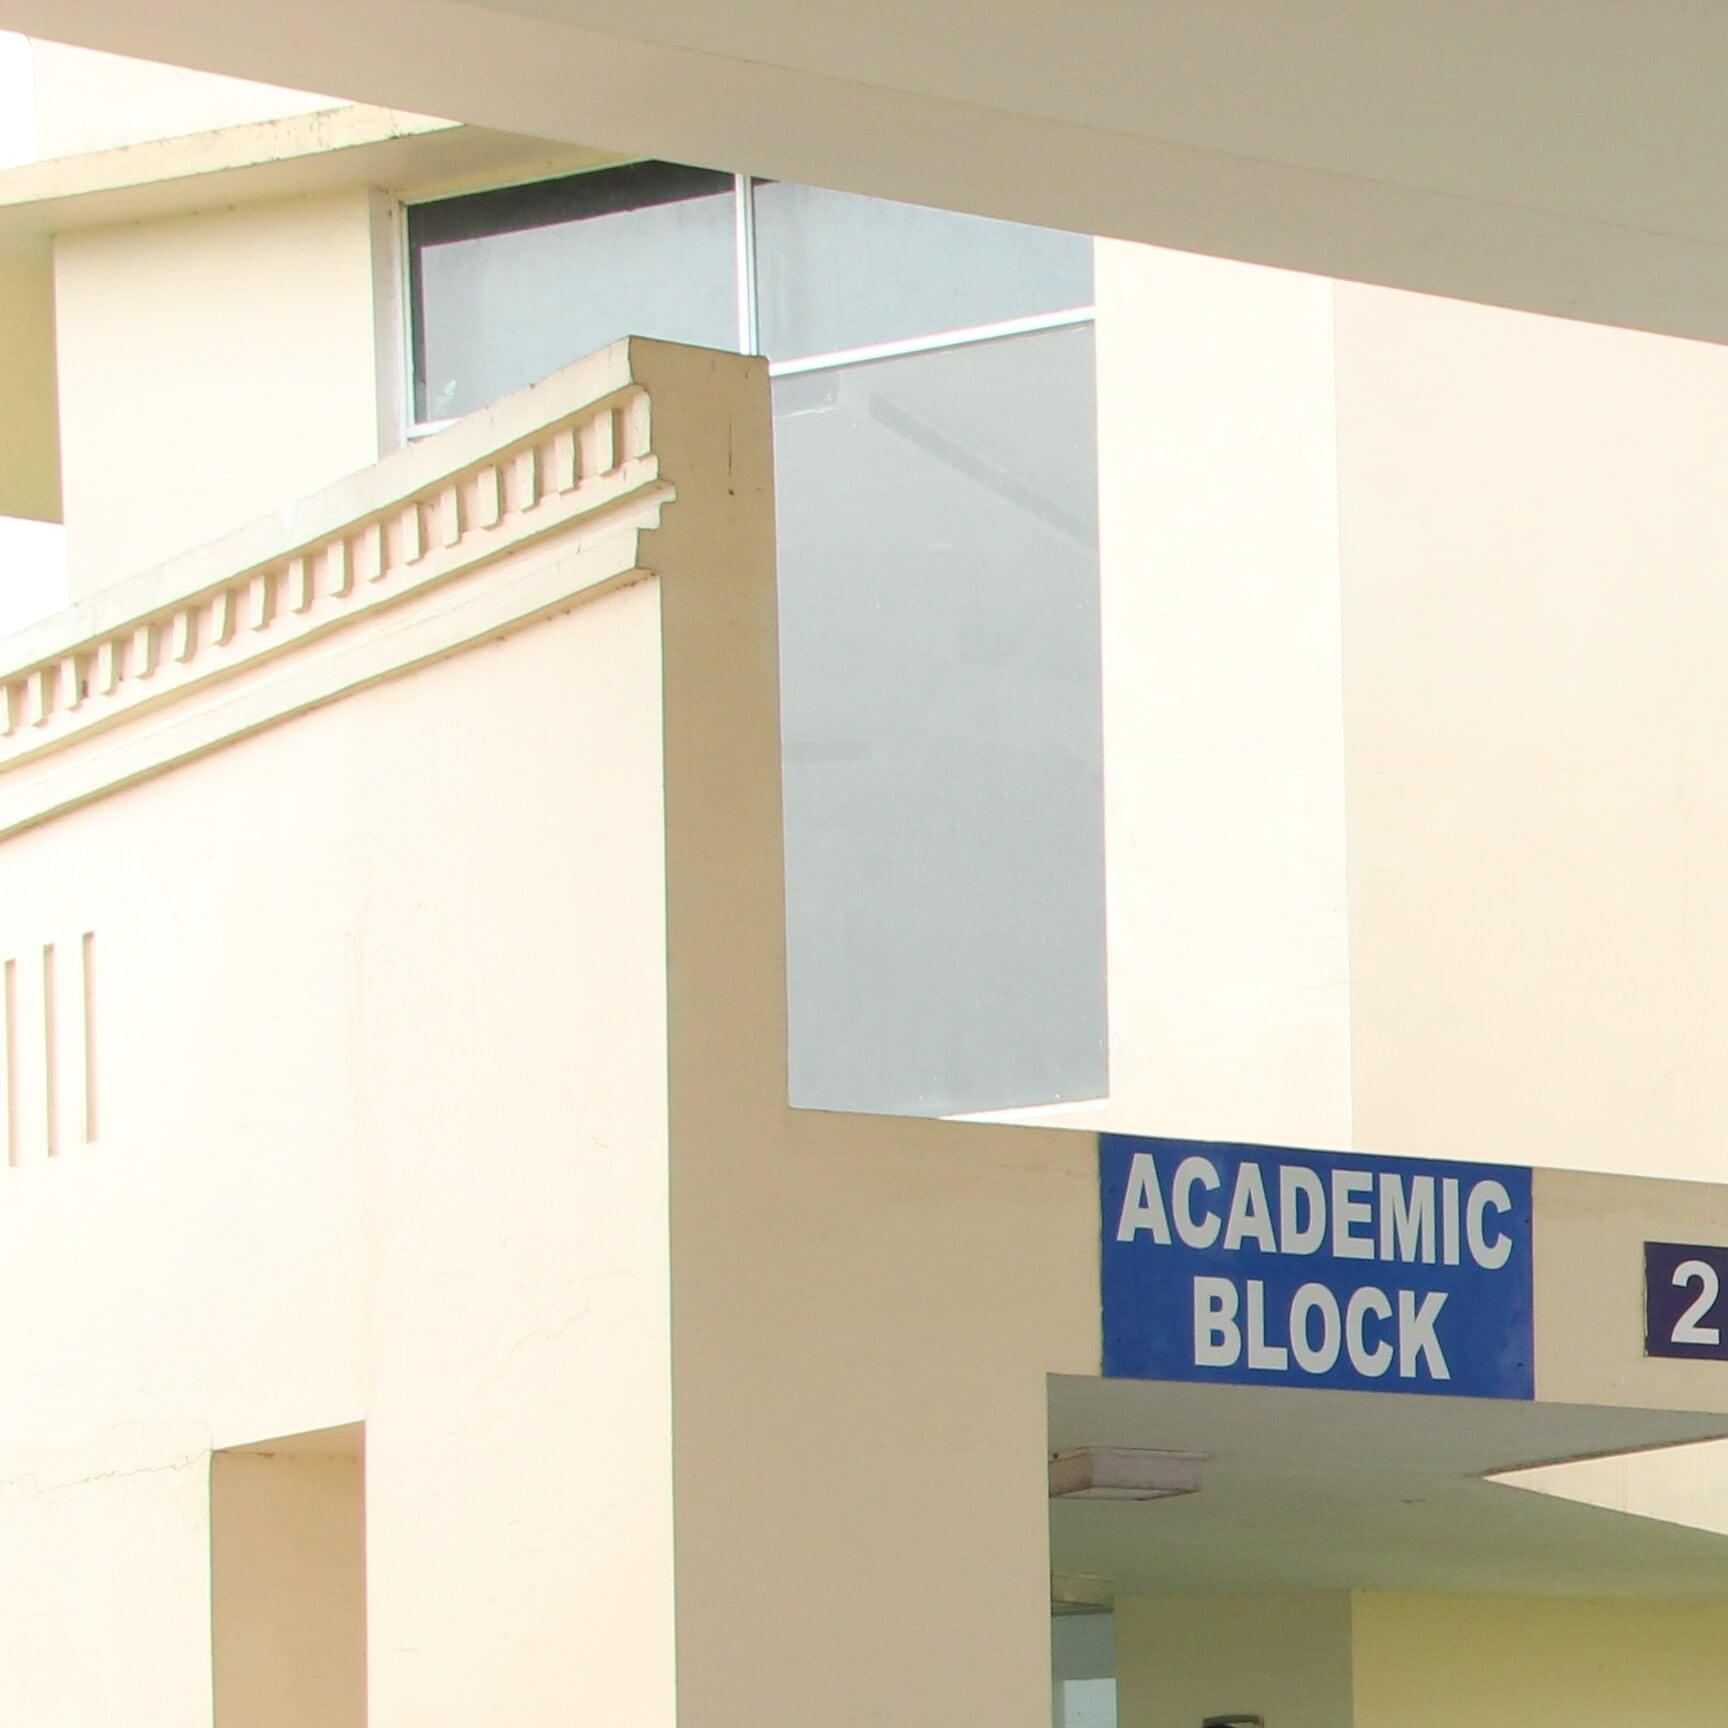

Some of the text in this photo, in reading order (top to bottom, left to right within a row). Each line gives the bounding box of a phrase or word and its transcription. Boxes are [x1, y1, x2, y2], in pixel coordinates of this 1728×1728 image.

[1116, 1153, 1513, 1269] ACADEMIC
[1194, 1276, 1451, 1380] BLOCK
[1671, 1260, 1720, 1344] 2
